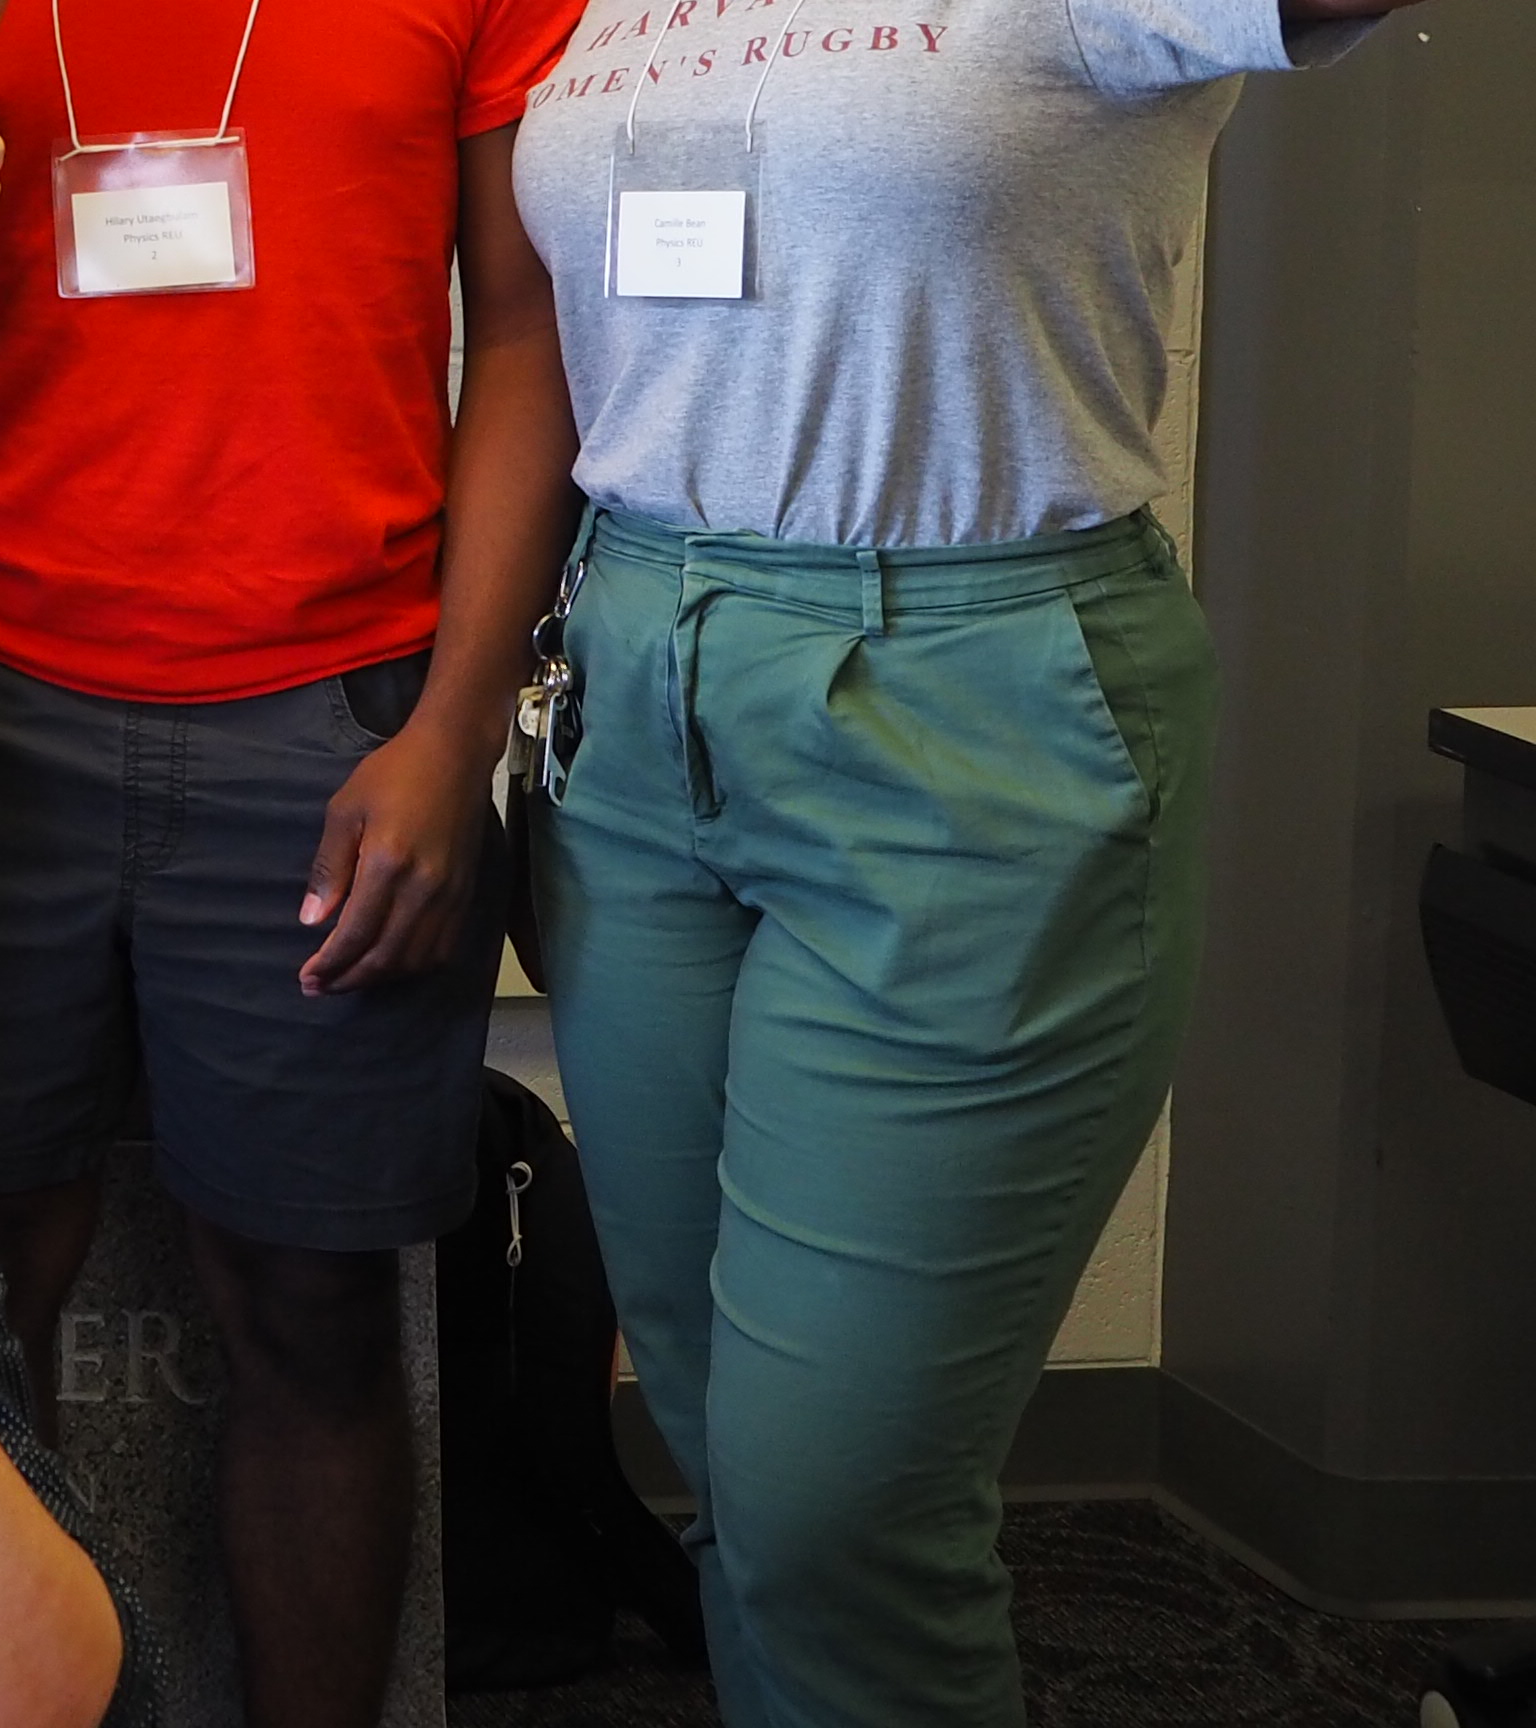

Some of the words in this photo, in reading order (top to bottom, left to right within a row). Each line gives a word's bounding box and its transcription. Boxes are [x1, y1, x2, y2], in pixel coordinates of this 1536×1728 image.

[530, 49, 717, 110] OMEN'S
[740, 23, 949, 67] RUGBY
[123, 233, 159, 246] Physics
[55, 1307, 208, 1405] ER
